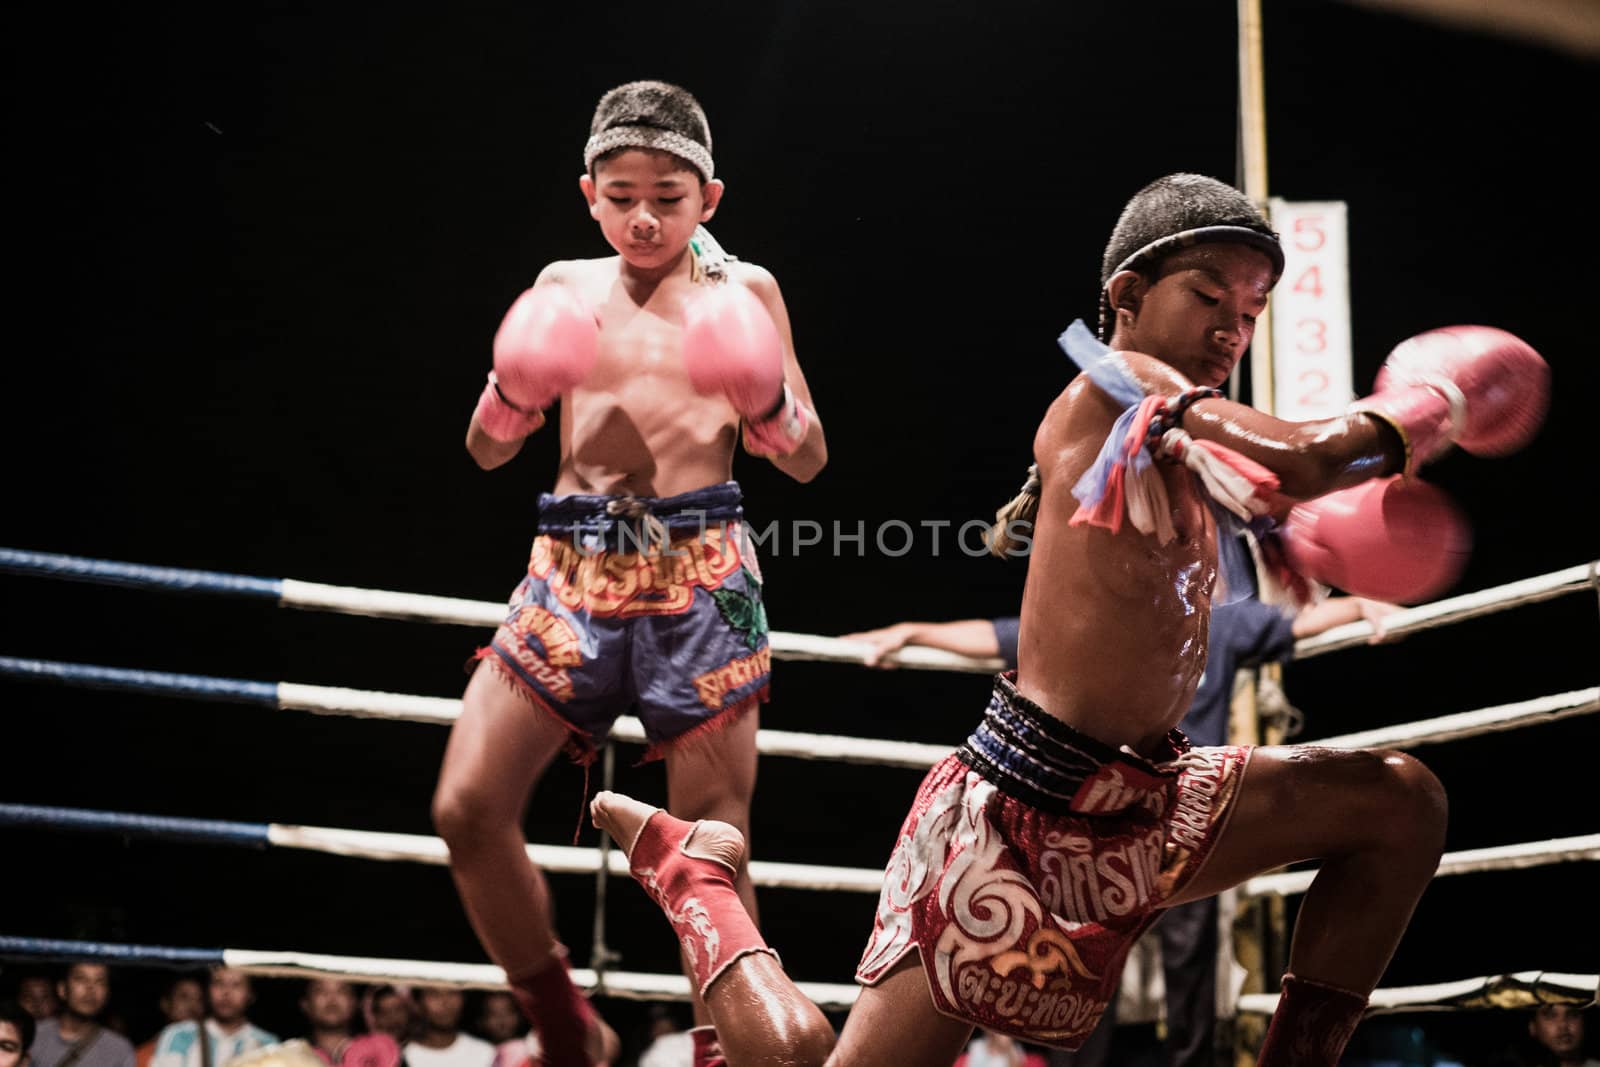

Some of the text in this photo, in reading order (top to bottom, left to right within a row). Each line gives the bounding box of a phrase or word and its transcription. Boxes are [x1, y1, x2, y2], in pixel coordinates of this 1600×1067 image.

[1292, 215, 1330, 406] 5 4 3 2
